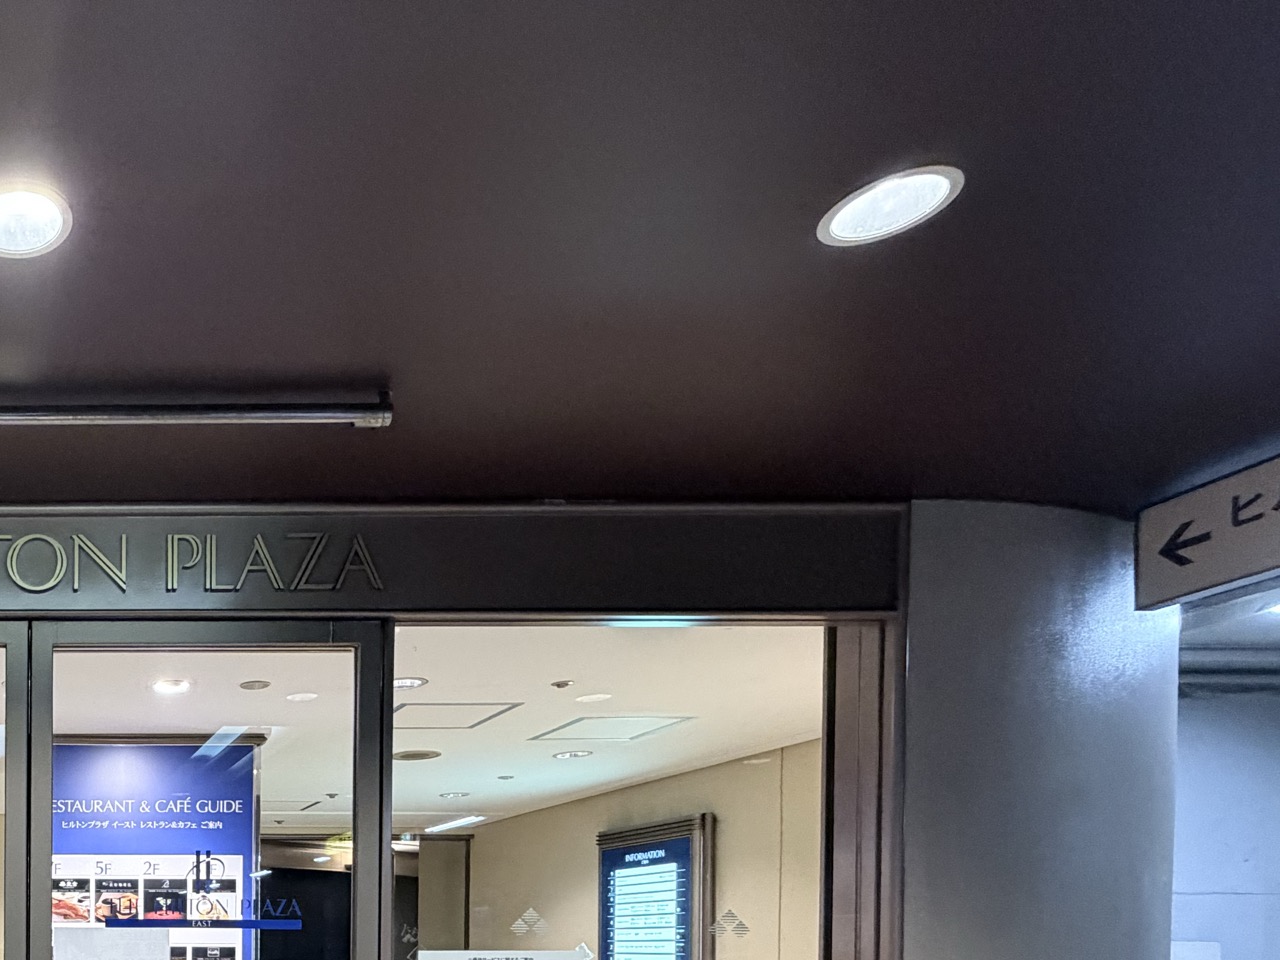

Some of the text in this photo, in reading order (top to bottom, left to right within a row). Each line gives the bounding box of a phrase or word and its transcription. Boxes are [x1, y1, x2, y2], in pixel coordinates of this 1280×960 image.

[165, 531, 384, 591] PLAZA
[52, 796, 244, 813] ESTAURANT & CAFÉ GUIDE
[61, 820, 109, 830] ヒルトンプラザ
[111, 820, 137, 830] イースト
[625, 849, 665, 863] INFORMATION
[94, 860, 112, 875] 5F
[143, 860, 160, 875] 2F
[191, 919, 213, 928] EAST
